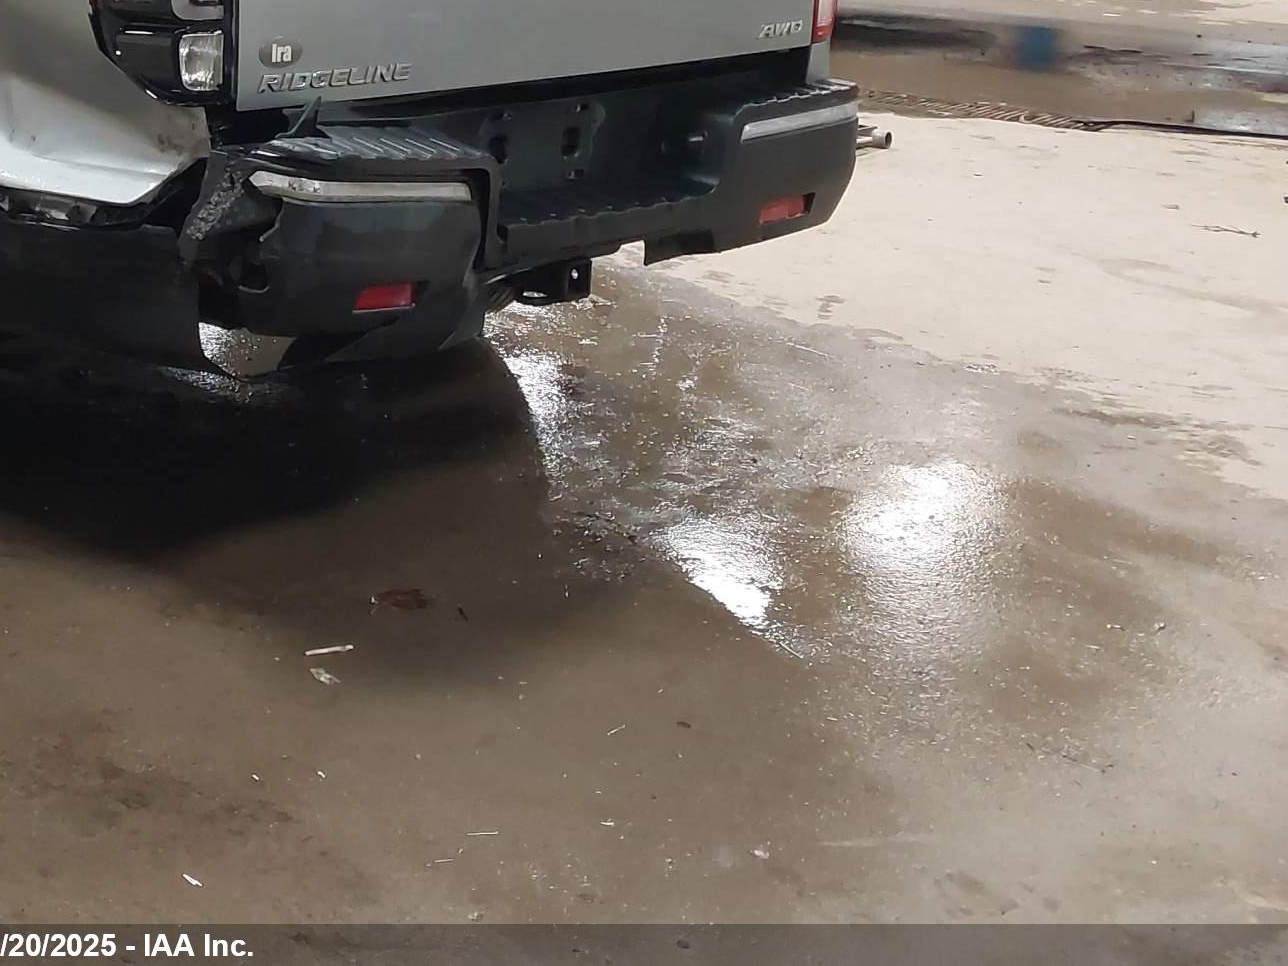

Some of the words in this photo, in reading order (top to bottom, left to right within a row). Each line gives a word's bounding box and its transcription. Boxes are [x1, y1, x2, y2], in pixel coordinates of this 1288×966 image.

[759, 19, 803, 39] AWD
[271, 43, 292, 63] Ira
[257, 63, 413, 95] RIDGELINE
